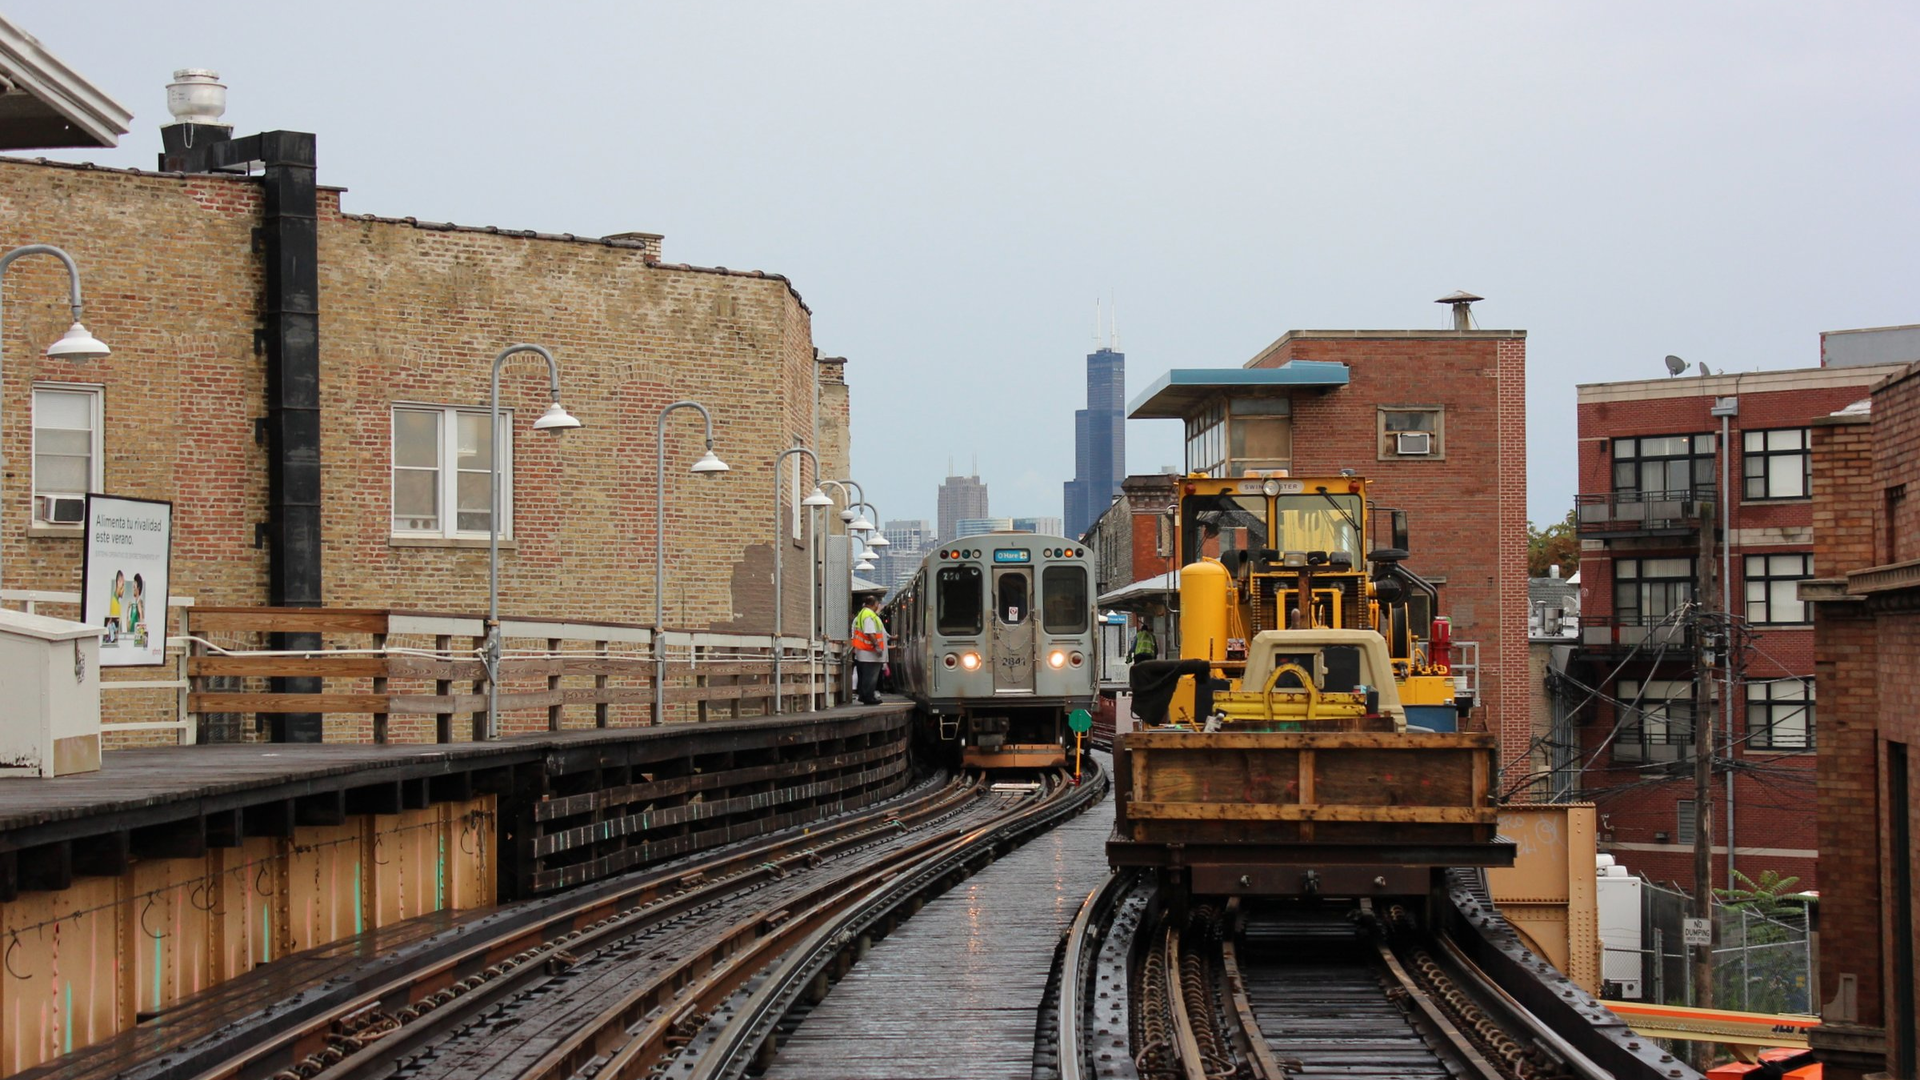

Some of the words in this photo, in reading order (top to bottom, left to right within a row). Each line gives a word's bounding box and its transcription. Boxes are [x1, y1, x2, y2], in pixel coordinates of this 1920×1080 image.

[96, 514, 126, 529] Alimenta
[127, 518, 134, 530] tu
[134, 518, 162, 532] rivalidad
[96, 531, 110, 543] este
[111, 533, 134, 545] verano.
[1694, 920, 1703, 928] NO
[1685, 928, 1710, 937] DUMPING
